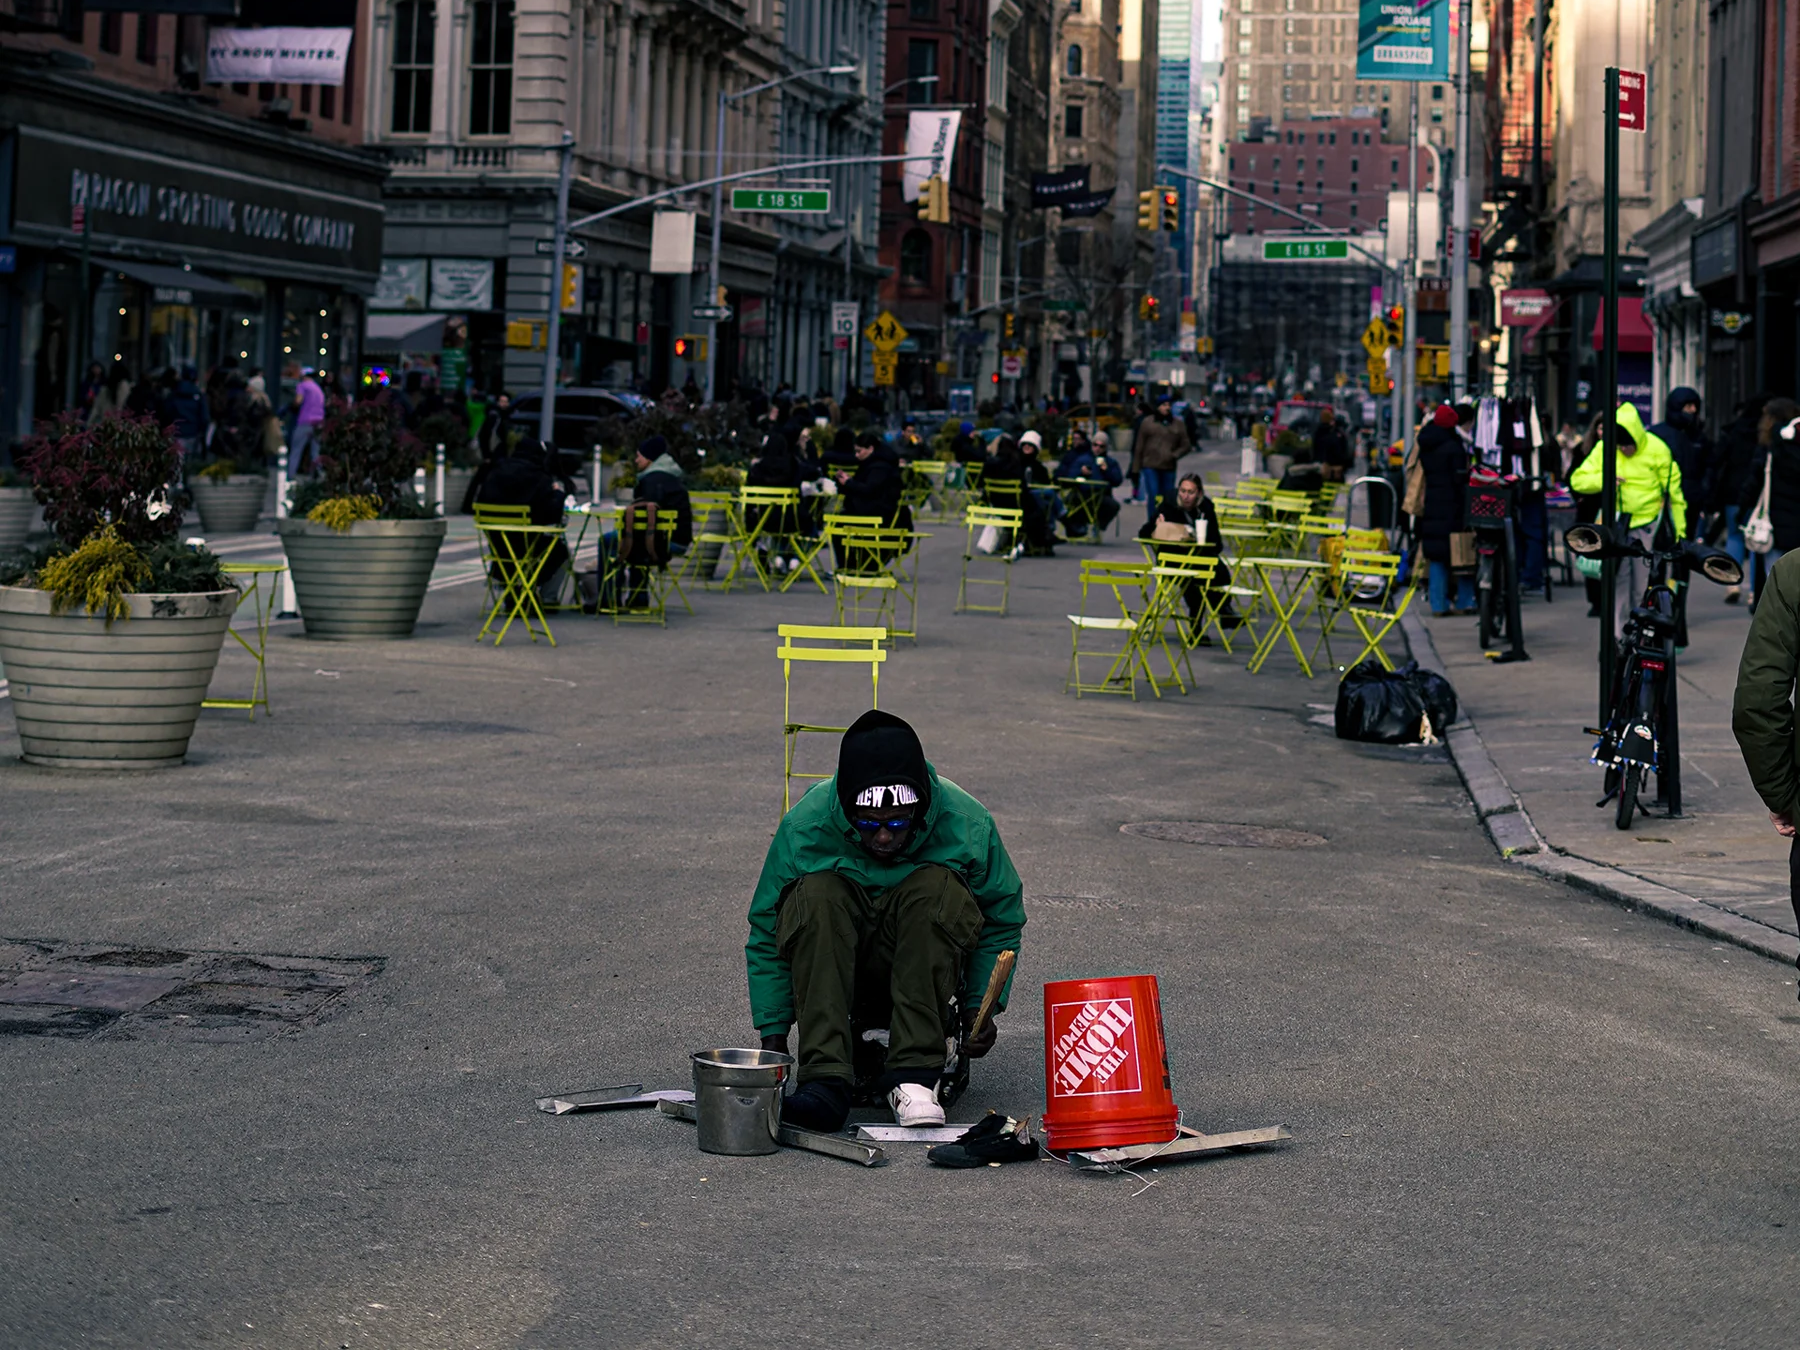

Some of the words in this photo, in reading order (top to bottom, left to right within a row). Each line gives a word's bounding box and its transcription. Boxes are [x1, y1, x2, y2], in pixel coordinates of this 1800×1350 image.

[1381, 4, 1413, 15] UNION
[1393, 16, 1432, 27] SQUARE
[231, 48, 275, 59] KNOW
[279, 49, 341, 61] WINTER.
[1377, 48, 1429, 61] URBANSPACE
[1619, 74, 1641, 90] TANDING
[757, 193, 764, 207] E
[770, 193, 785, 207] 18
[790, 194, 804, 208] St
[70, 167, 151, 218] PARAGON
[156, 186, 237, 233] SPORTING
[242, 202, 289, 242] GOODS
[293, 212, 356, 250] COMPANY
[1286, 244, 1292, 256] E
[1297, 244, 1311, 256] 18
[1315, 243, 1327, 256] St
[837, 319, 853, 332] 10
[880, 364, 889, 377] 5
[856, 785, 886, 808] NEW
[887, 784, 919, 806] YORK
[1053, 1002, 1100, 1062] DEPOT
[1054, 1000, 1133, 1095] HOME
[1092, 1045, 1129, 1084] THE
